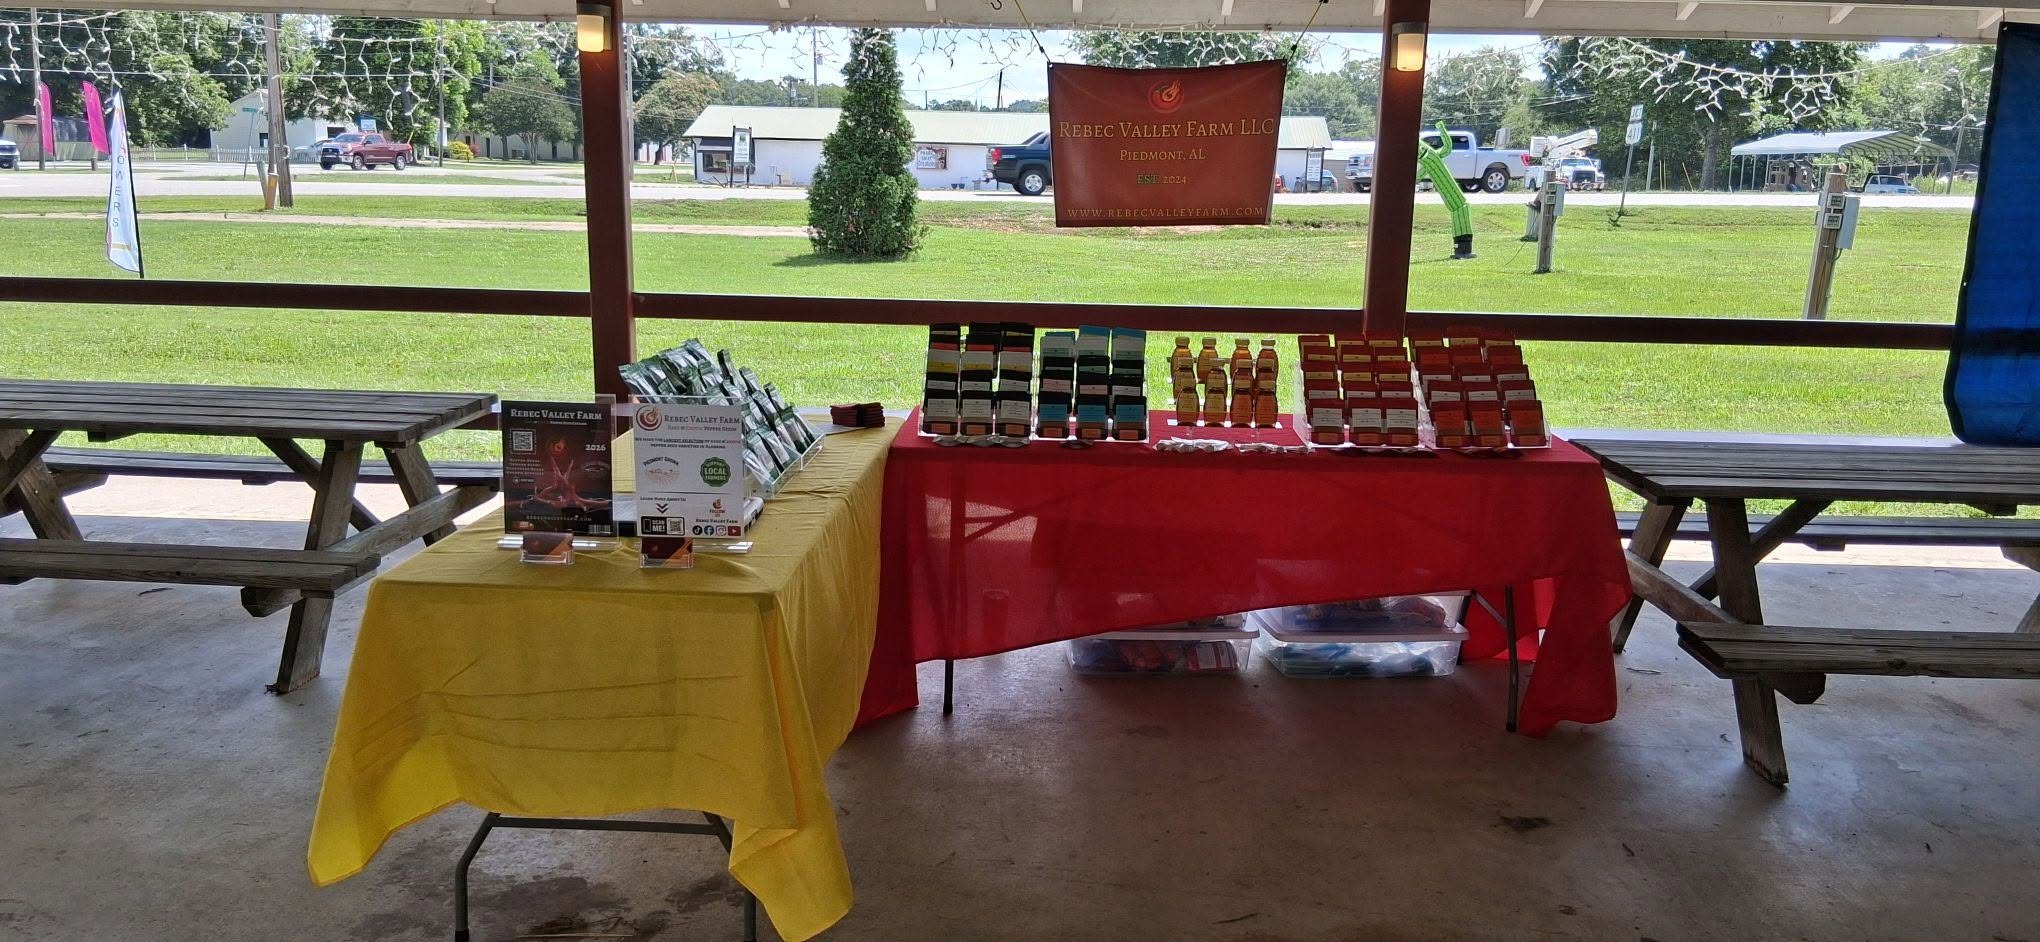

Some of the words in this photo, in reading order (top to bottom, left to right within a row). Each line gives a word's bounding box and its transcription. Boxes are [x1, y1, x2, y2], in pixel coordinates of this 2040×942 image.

[1630, 107, 1643, 119] JCT
[1058, 121, 1115, 138] REBEC
[1118, 121, 1182, 138] VALLEY
[1186, 120, 1234, 137] FARM
[1240, 118, 1275, 136] LLC
[1628, 127, 1641, 140] 411
[1119, 149, 1187, 162] PIEDMONT,
[1188, 148, 1207, 161] AL
[1162, 174, 1188, 185] 2024
[1067, 206, 1264, 218] WWW.REBECVALLEYFARM.COM
[510, 408, 540, 418] REBEC
[541, 409, 576, 419] VALLEY
[577, 410, 602, 420] FARM
[664, 414, 689, 423] REBEC
[690, 415, 718, 424] VALLEY
[719, 416, 740, 424] FARM
[585, 443, 607, 451] 2026
[704, 467, 727, 475] LOCAL
